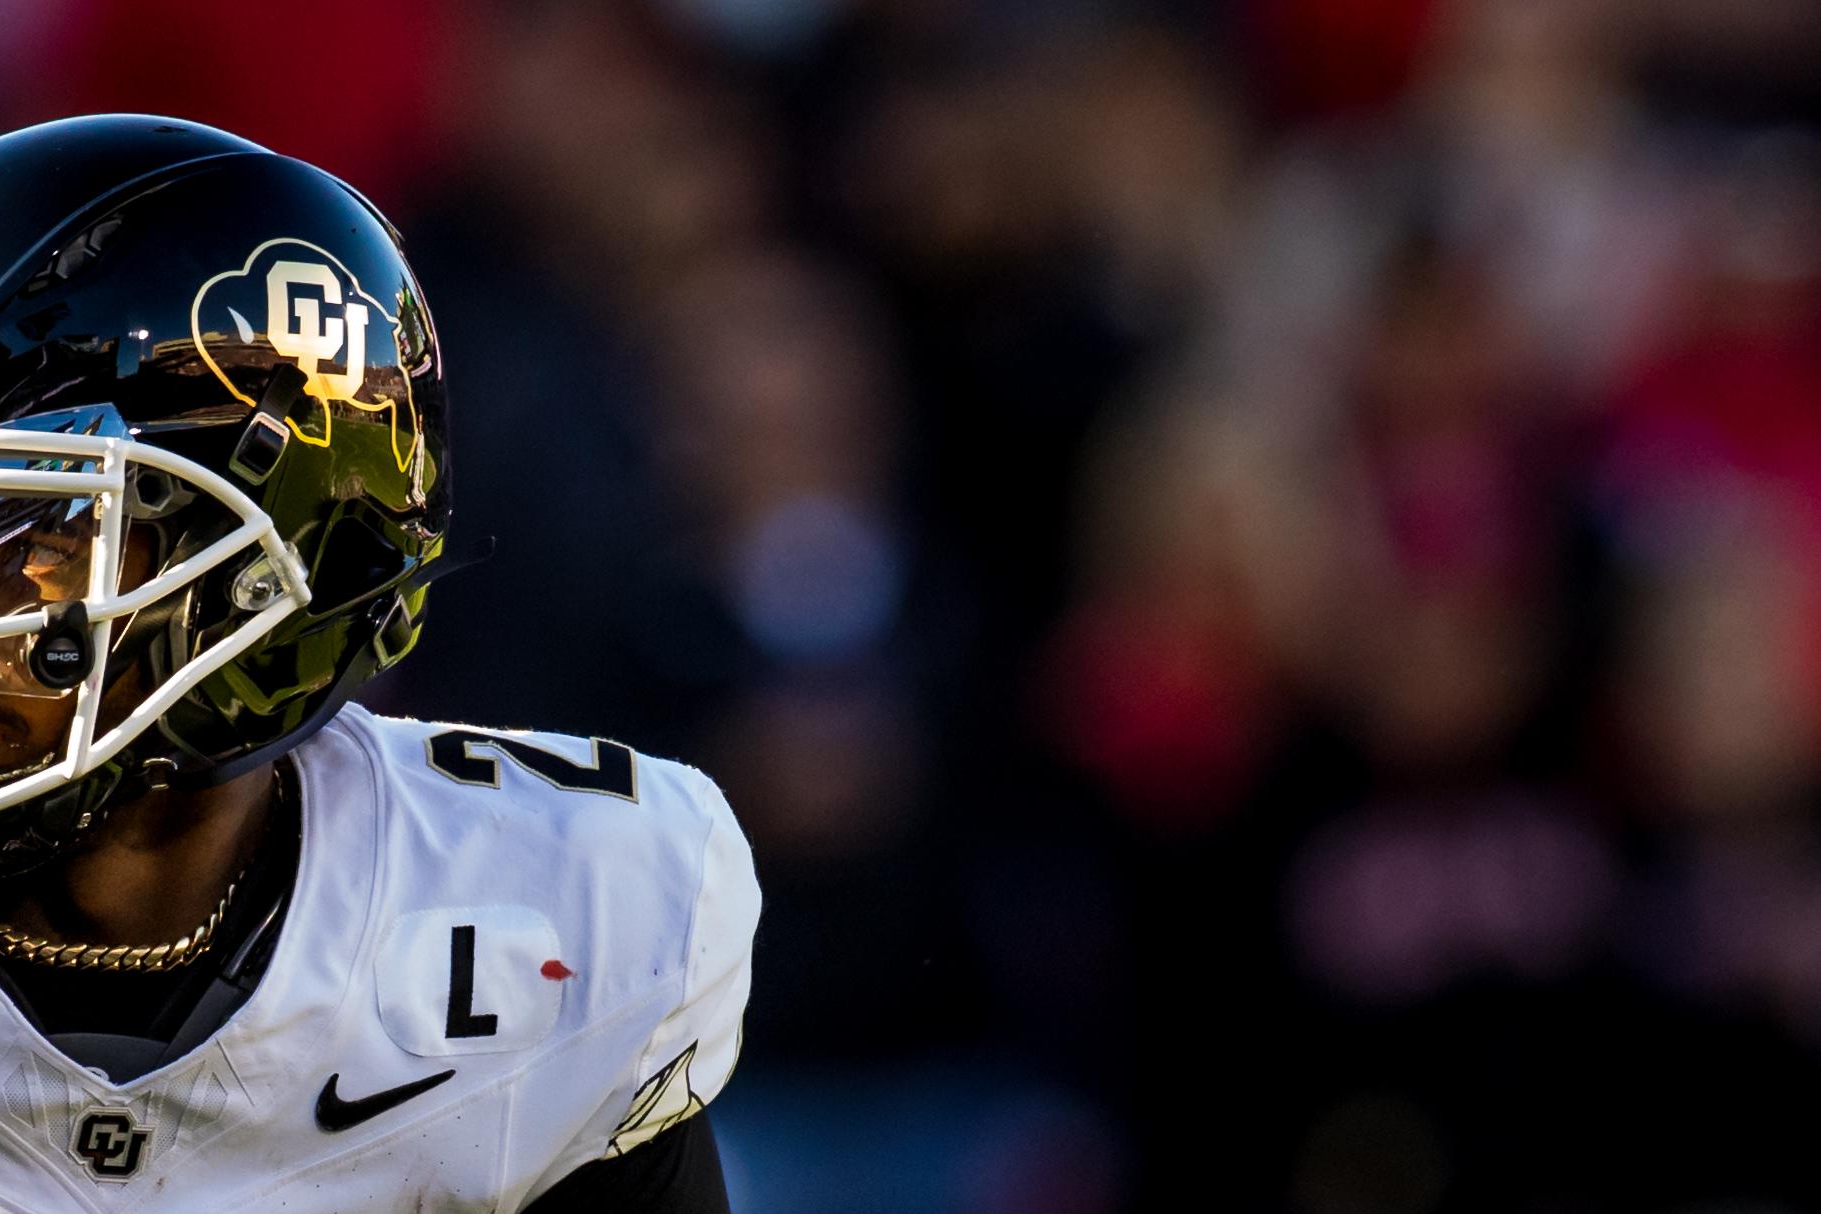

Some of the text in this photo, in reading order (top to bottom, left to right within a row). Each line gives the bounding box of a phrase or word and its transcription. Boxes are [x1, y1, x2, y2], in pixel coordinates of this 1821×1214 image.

[266, 260, 369, 401] CU
[425, 728, 640, 804] 2
[444, 925, 498, 1039] L
[76, 1113, 150, 1177] CU
